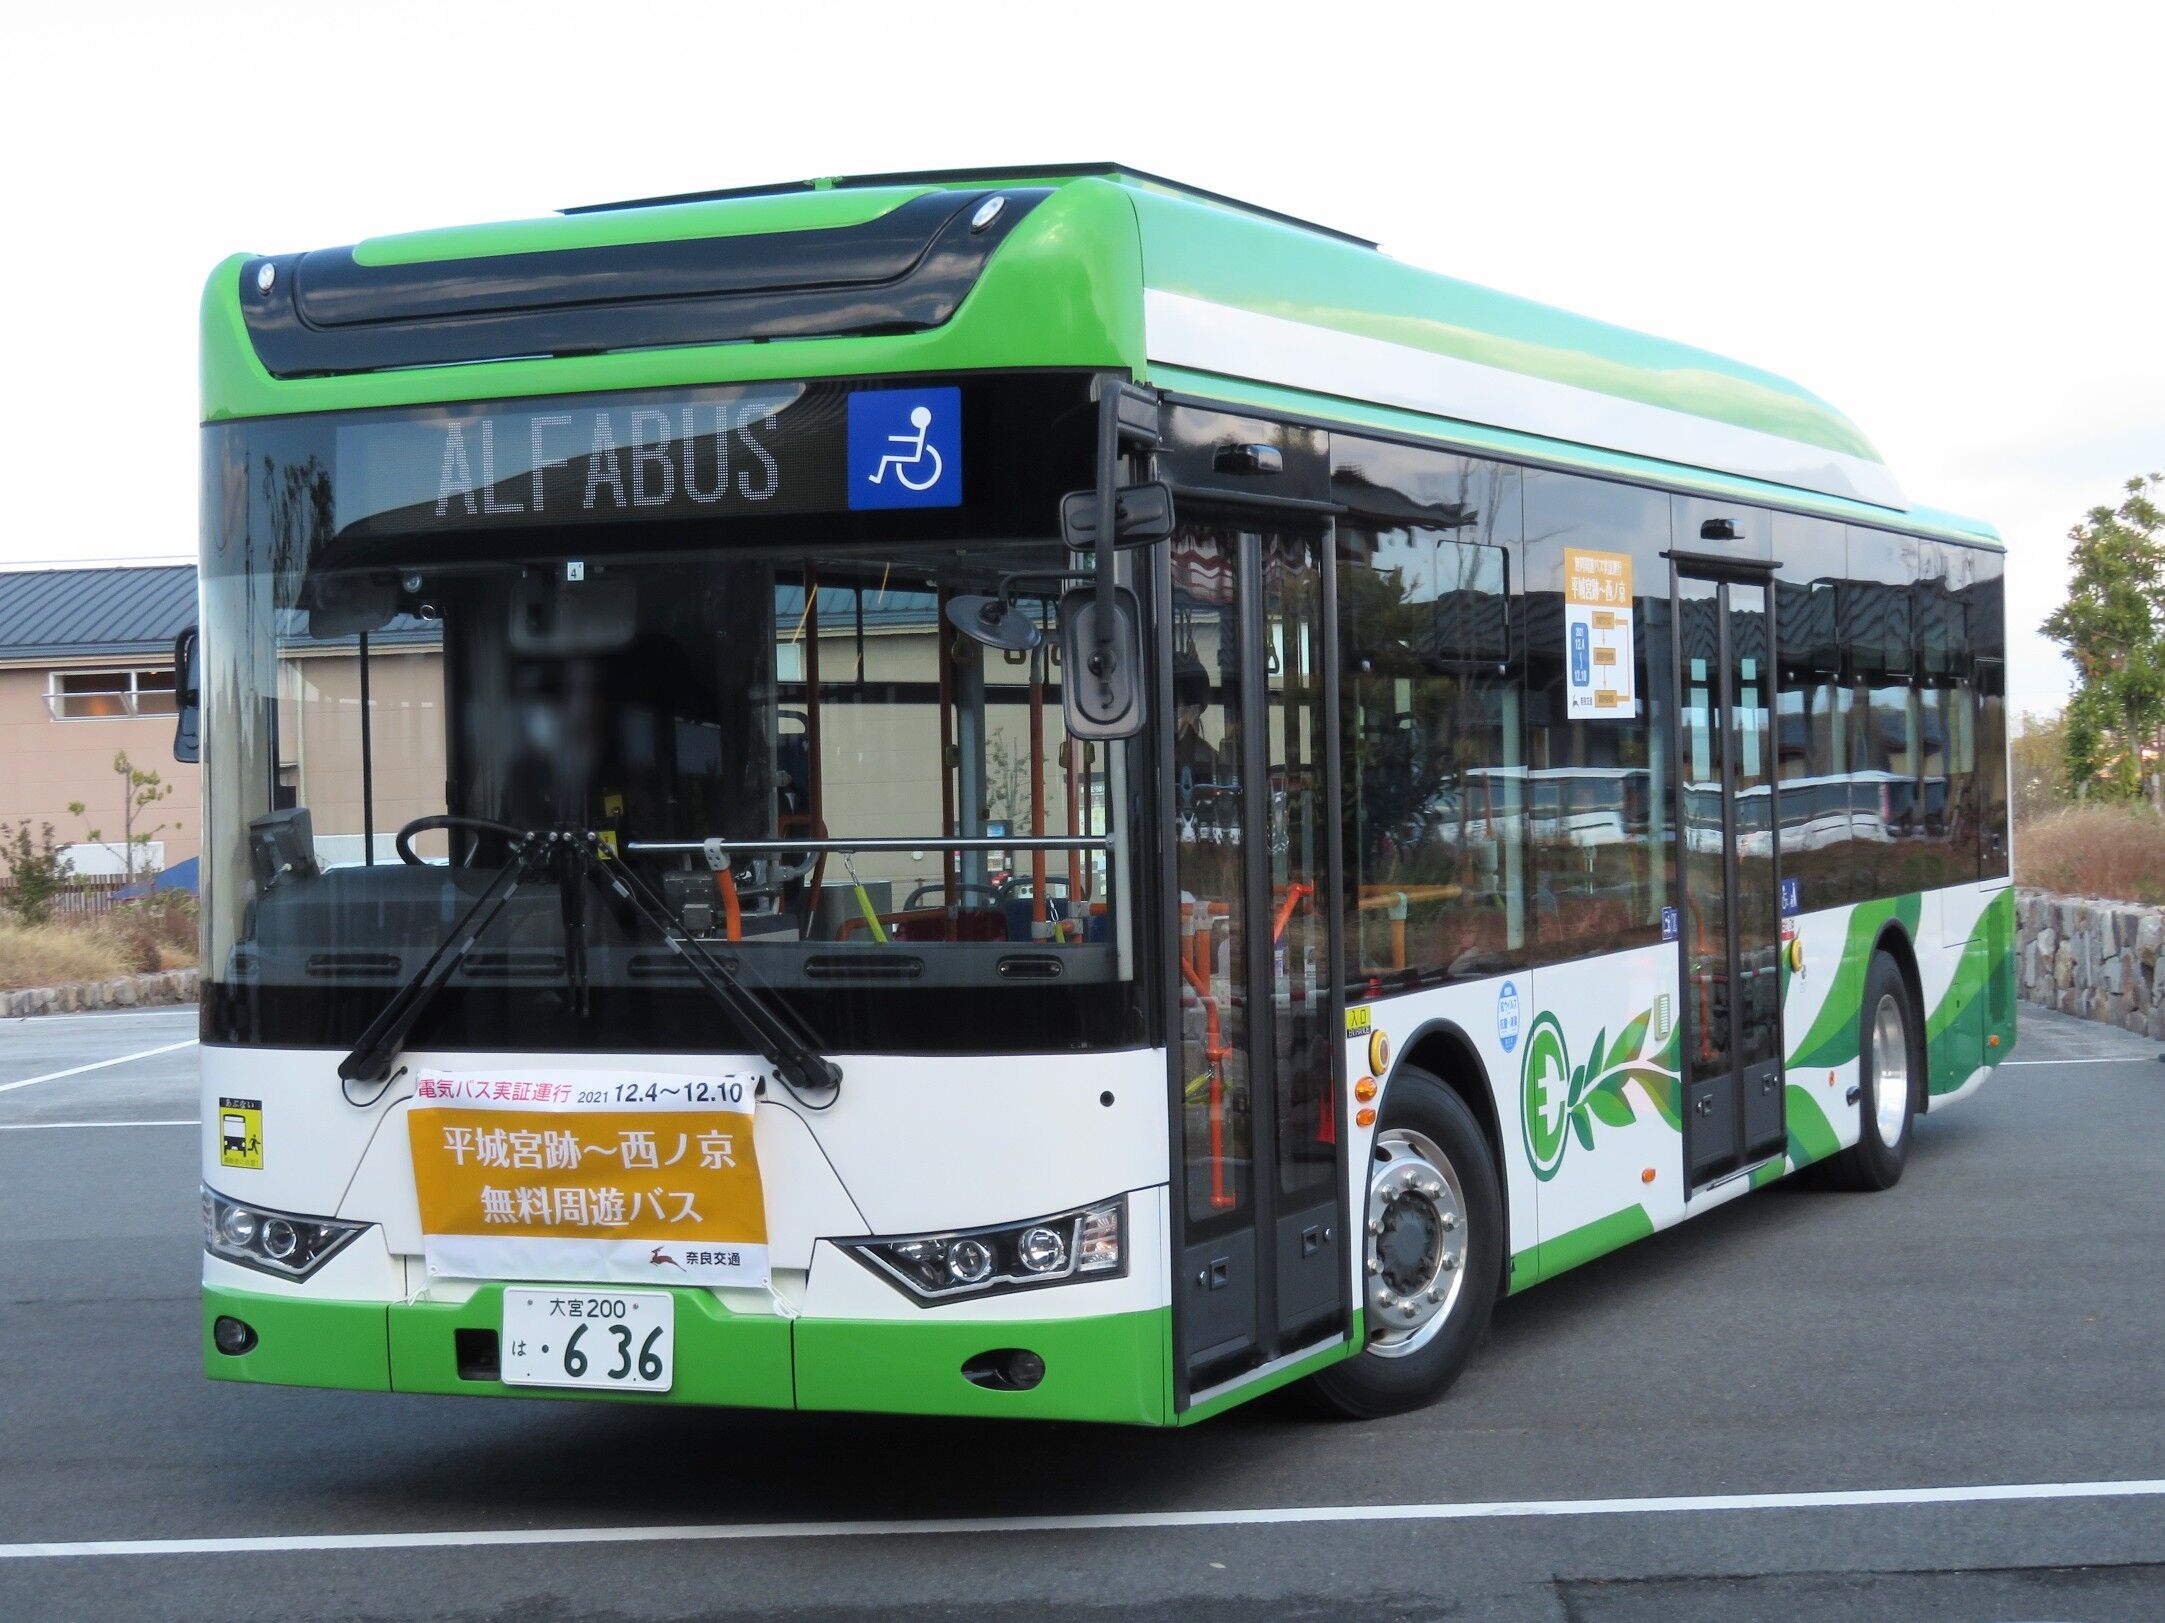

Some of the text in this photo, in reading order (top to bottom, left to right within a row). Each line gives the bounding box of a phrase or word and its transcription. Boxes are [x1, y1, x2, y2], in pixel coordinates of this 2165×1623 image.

[434, 403, 779, 517] ALFABUS
[1351, 1009, 1367, 1027] 入口
[418, 1079, 573, 1103] 電気バス実証運行
[577, 1091, 609, 1104] 2021
[225, 1098, 255, 1109] あぶない
[442, 1126, 737, 1170] 平城宮跡～西ノ京
[480, 1185, 703, 1227] 無料周遊バス
[685, 1251, 741, 1267] 奈良交通
[511, 1341, 527, 1357] は
